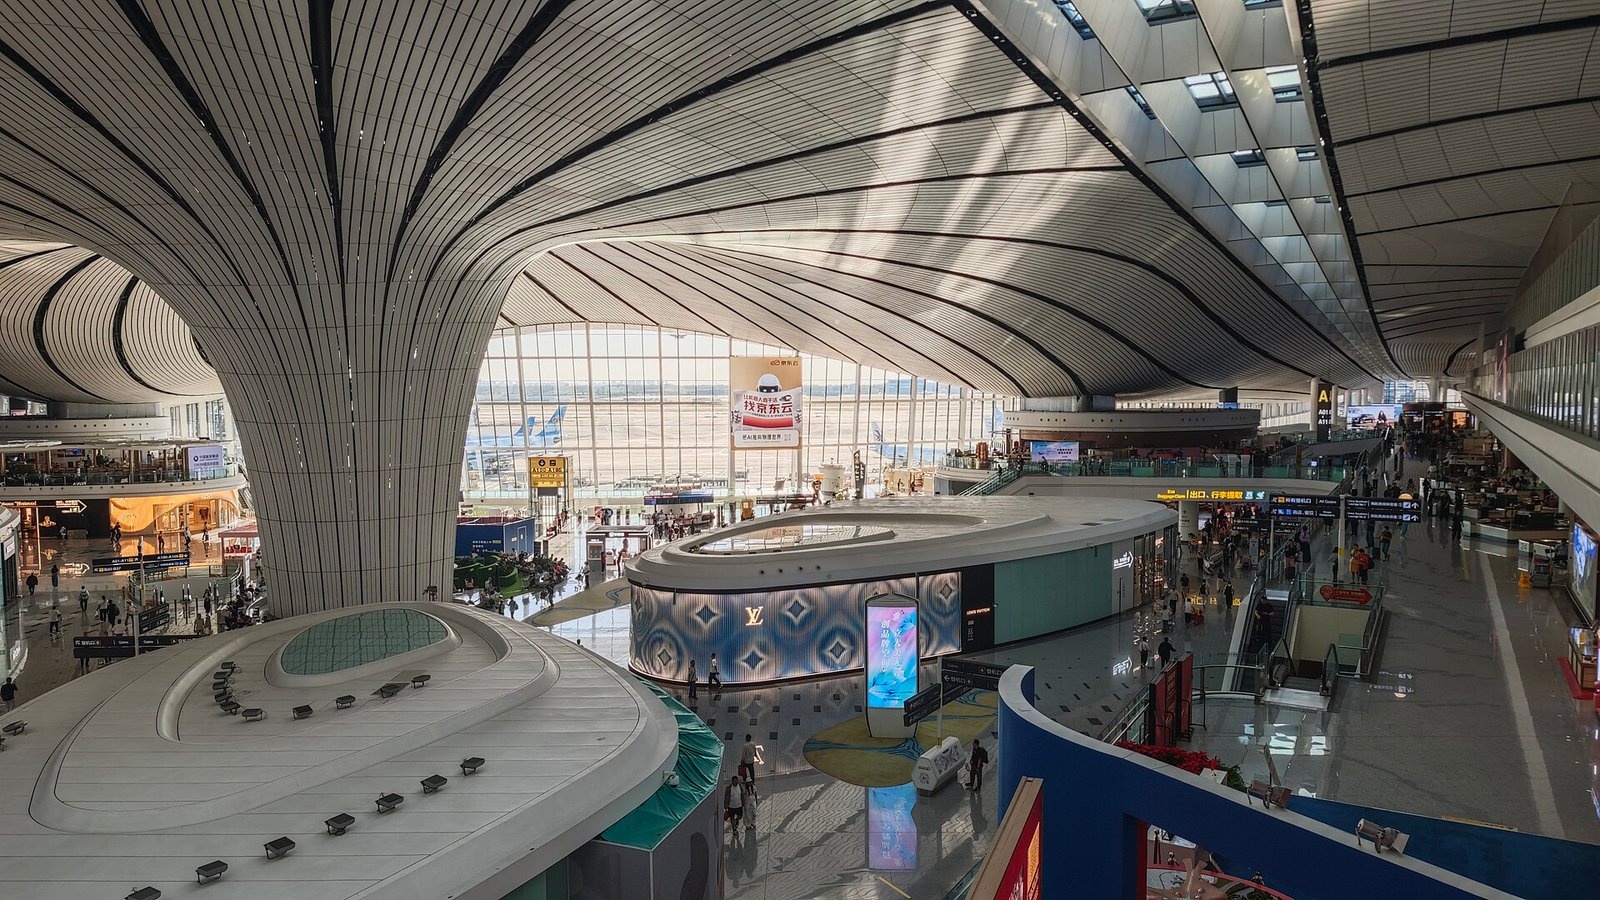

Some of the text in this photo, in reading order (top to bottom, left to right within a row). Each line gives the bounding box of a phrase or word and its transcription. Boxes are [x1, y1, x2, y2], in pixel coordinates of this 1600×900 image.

[1318, 389, 1328, 402] A
[743, 400, 792, 414] 找京东云
[1190, 490, 1243, 499] 出口、行李提取
[745, 606, 763, 626] LV
